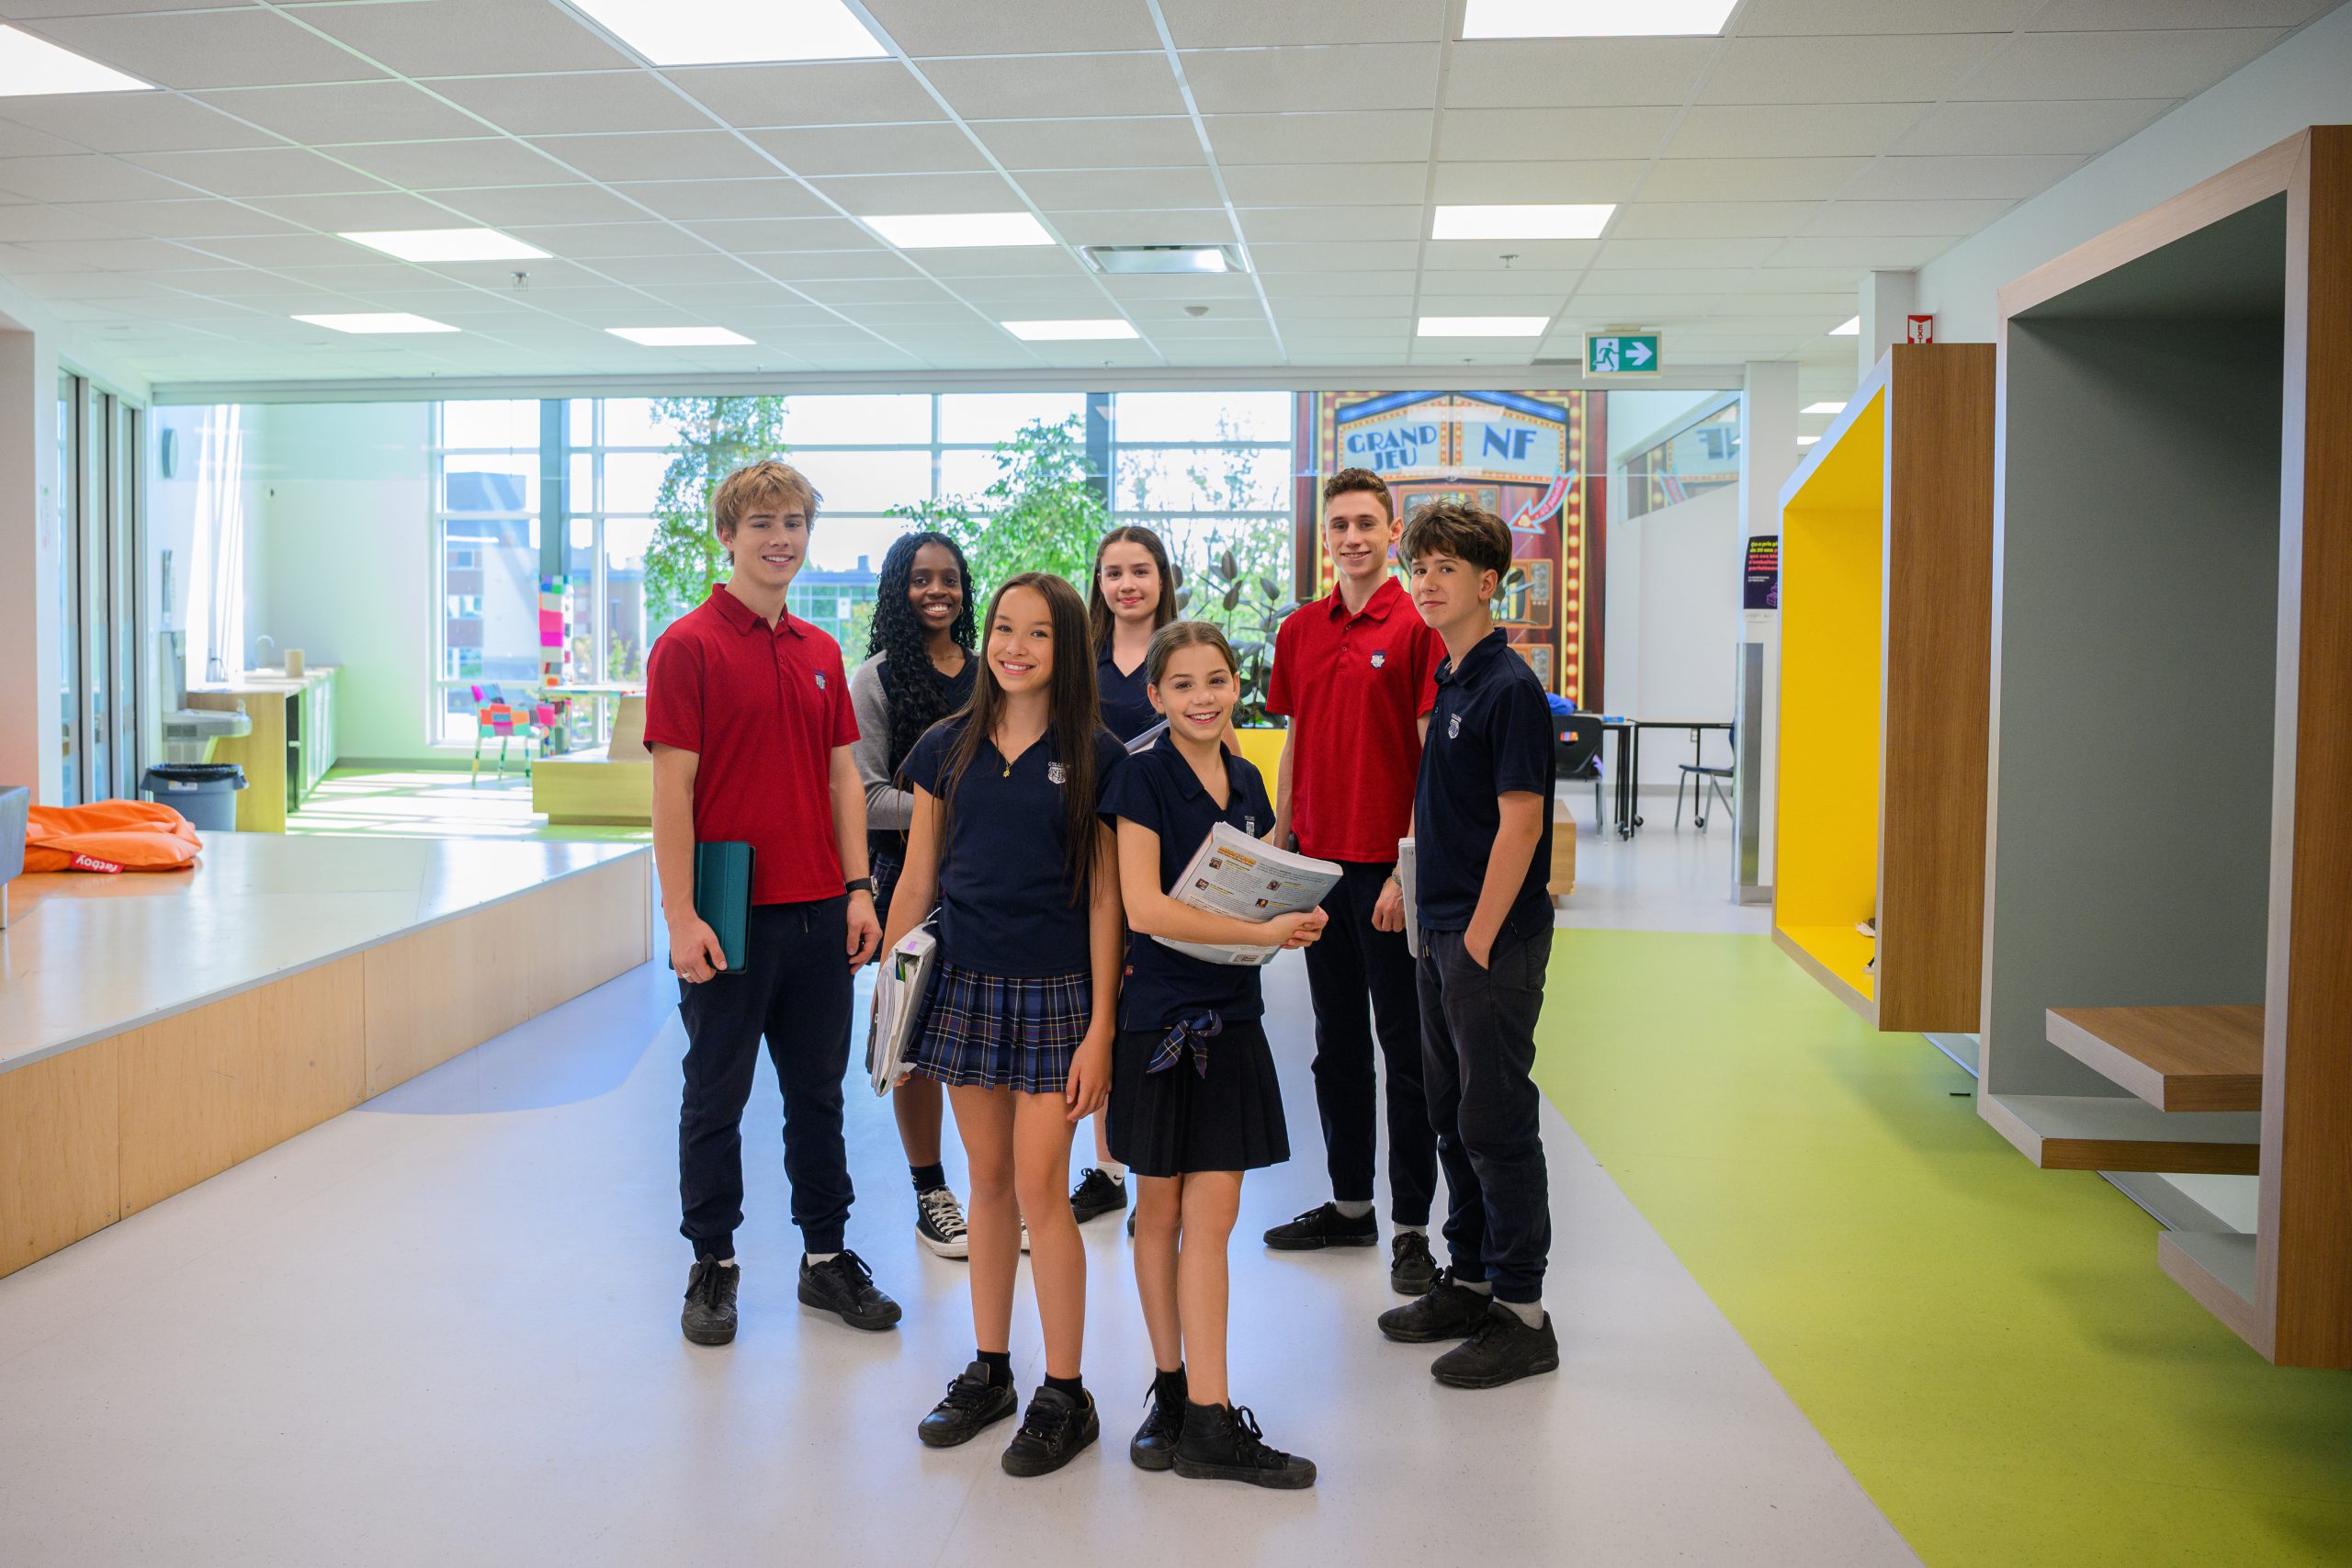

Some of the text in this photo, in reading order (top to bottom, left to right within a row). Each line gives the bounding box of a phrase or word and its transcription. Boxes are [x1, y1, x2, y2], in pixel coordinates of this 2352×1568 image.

[1347, 424, 1437, 454] GRAND
[1483, 423, 1538, 460] NF
[1371, 446, 1418, 471] JEU
[75, 854, 119, 873] fatboy
